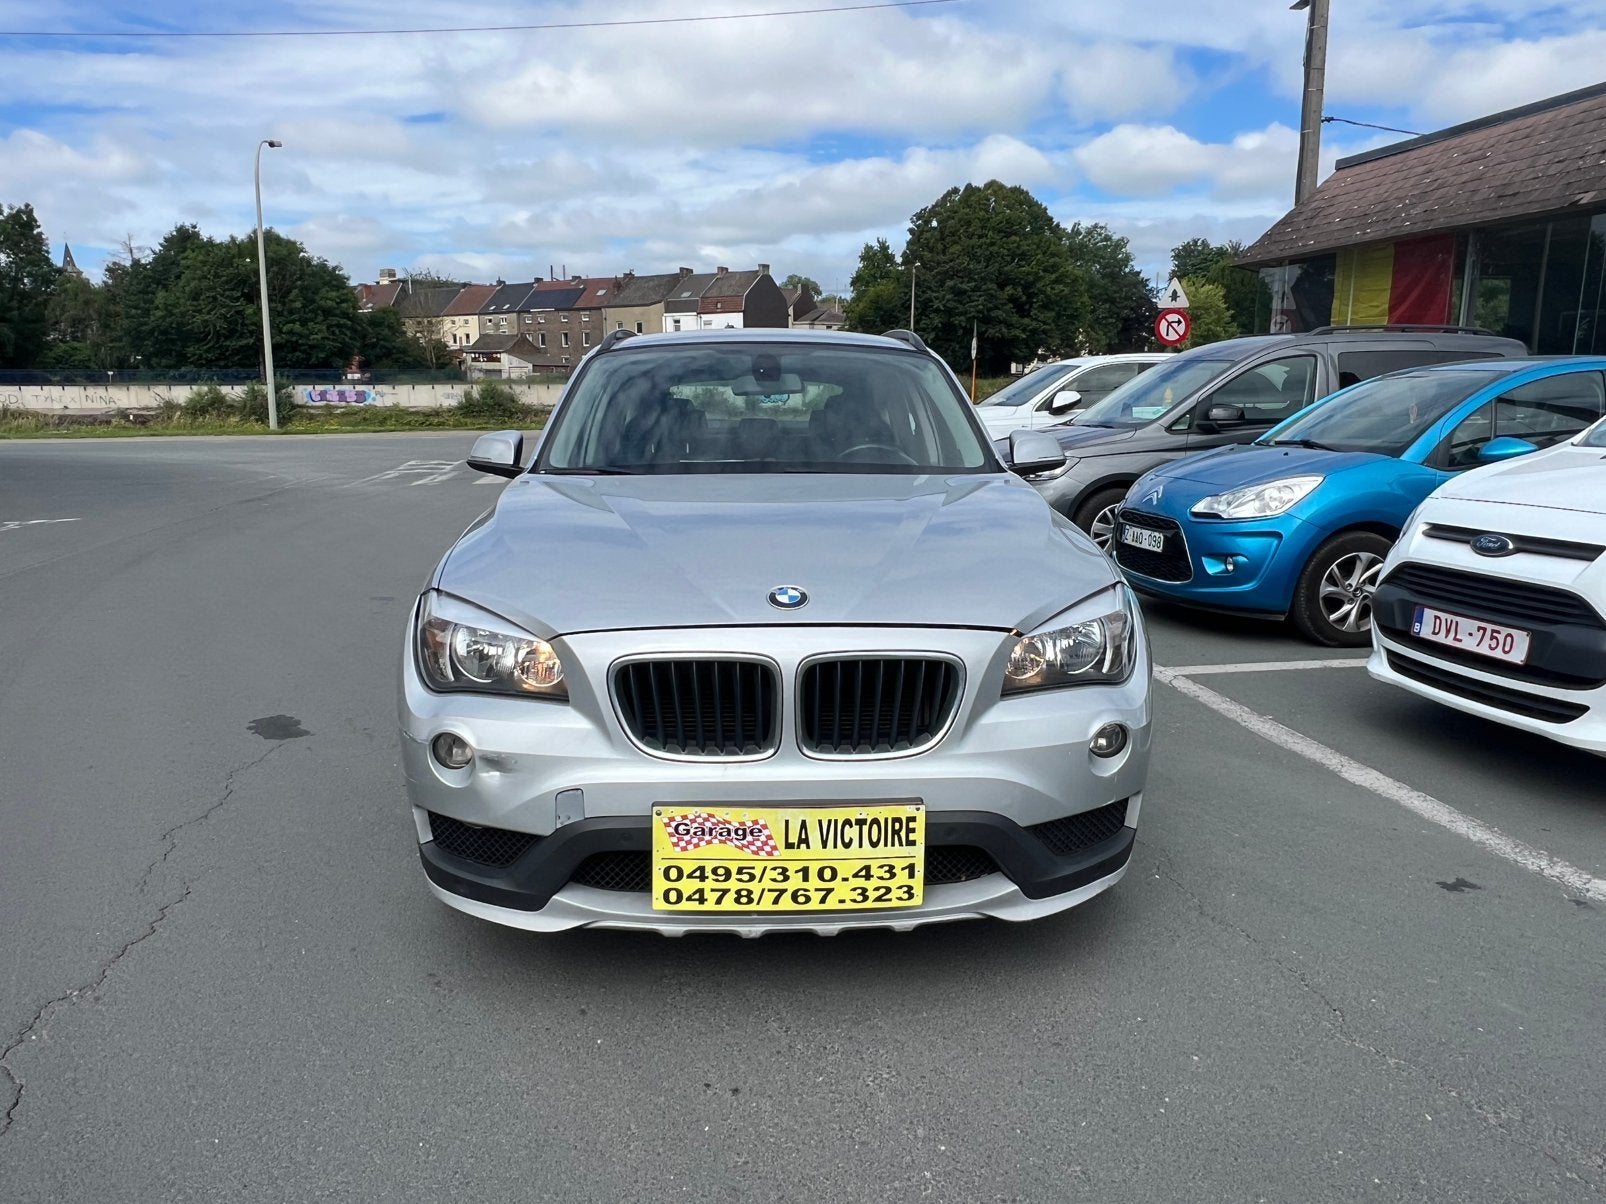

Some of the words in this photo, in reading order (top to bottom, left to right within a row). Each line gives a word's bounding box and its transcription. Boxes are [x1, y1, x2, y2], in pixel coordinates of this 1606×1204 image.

[1431, 614, 1514, 655] DVL-750
[673, 821, 763, 841] Garage
[783, 819, 811, 850] LA
[817, 815, 918, 849] VICTOIRE
[662, 862, 916, 884] 0495/310.431
[662, 884, 916, 906] 0478/767.323
